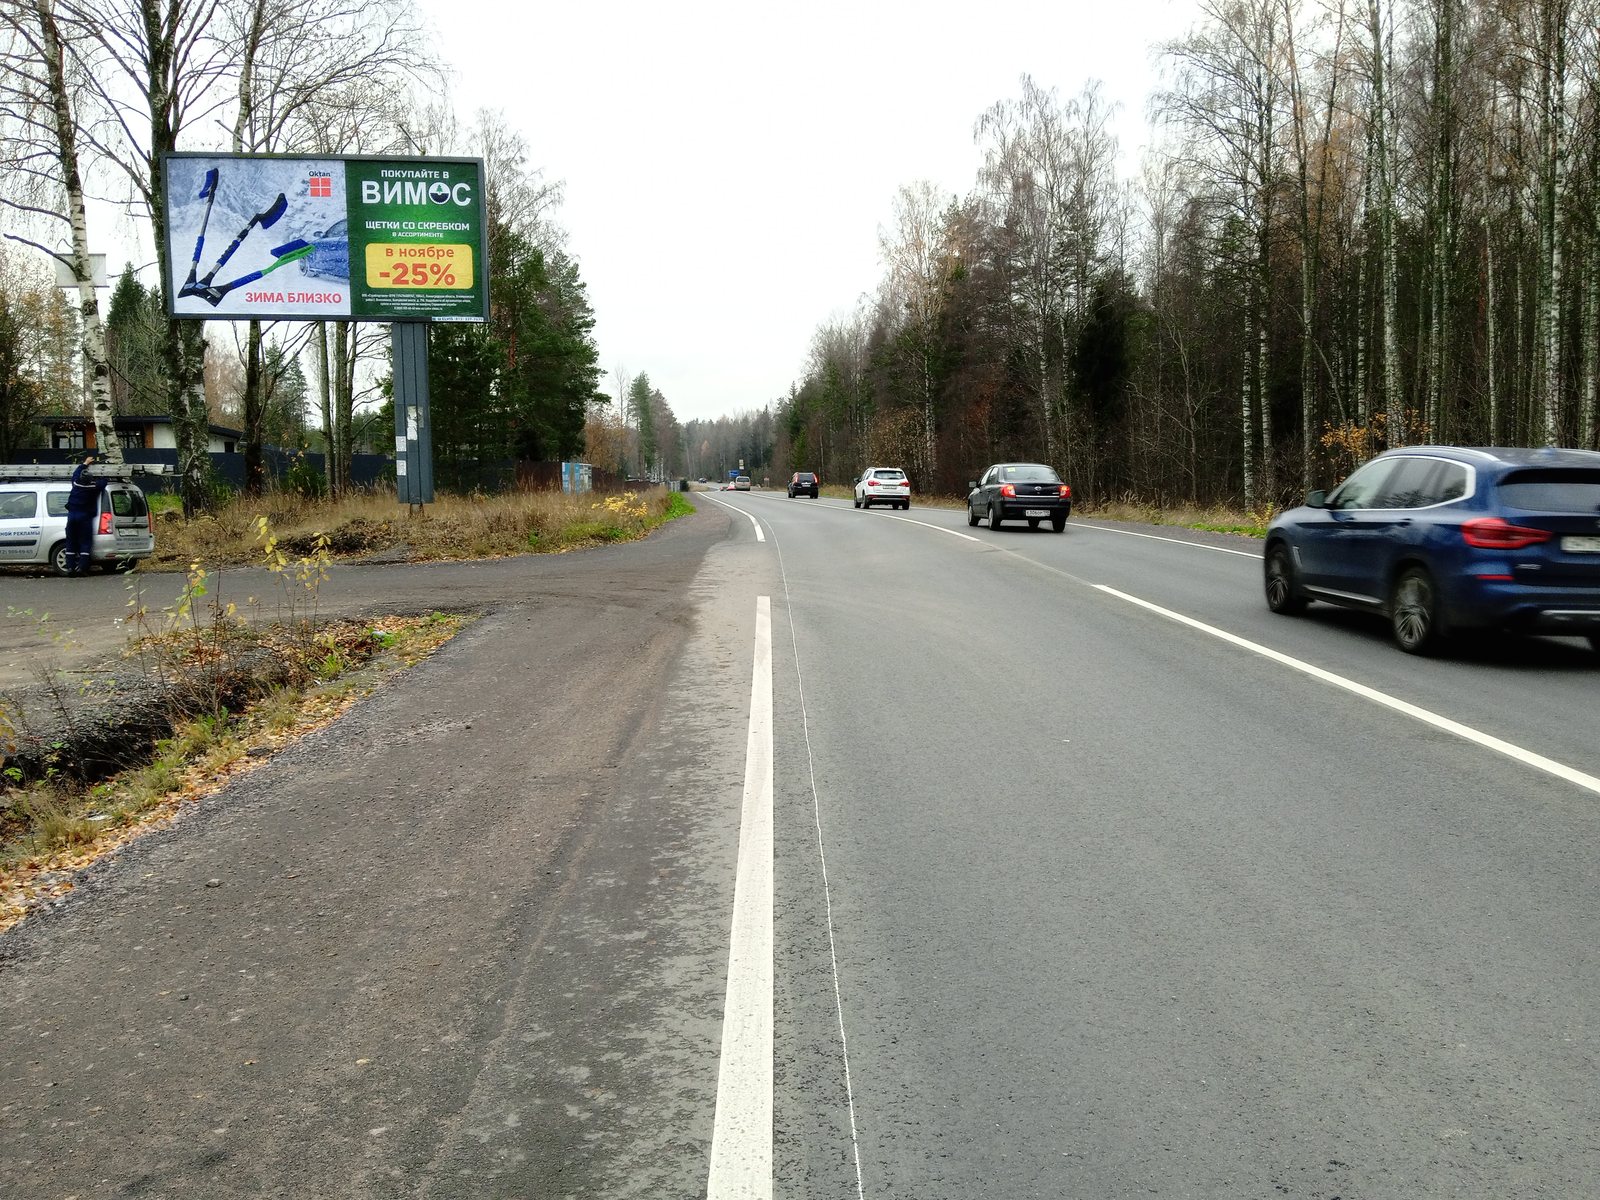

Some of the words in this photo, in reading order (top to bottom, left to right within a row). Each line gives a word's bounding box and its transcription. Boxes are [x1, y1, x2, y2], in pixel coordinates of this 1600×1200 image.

[381, 169, 440, 179] ПОКУПАЙТЕ
[442, 171, 450, 179] В
[361, 180, 472, 207] ВИМОС
[365, 220, 400, 230] ЩЕТКИ
[402, 221, 416, 230] СО
[417, 221, 470, 231] СКРЕБКОМ
[385, 248, 394, 257] в
[399, 246, 455, 260] ноябре
[379, 262, 456, 286] -25%
[245, 291, 285, 303] ЗИМА
[287, 292, 342, 304] БЛИЗКО
